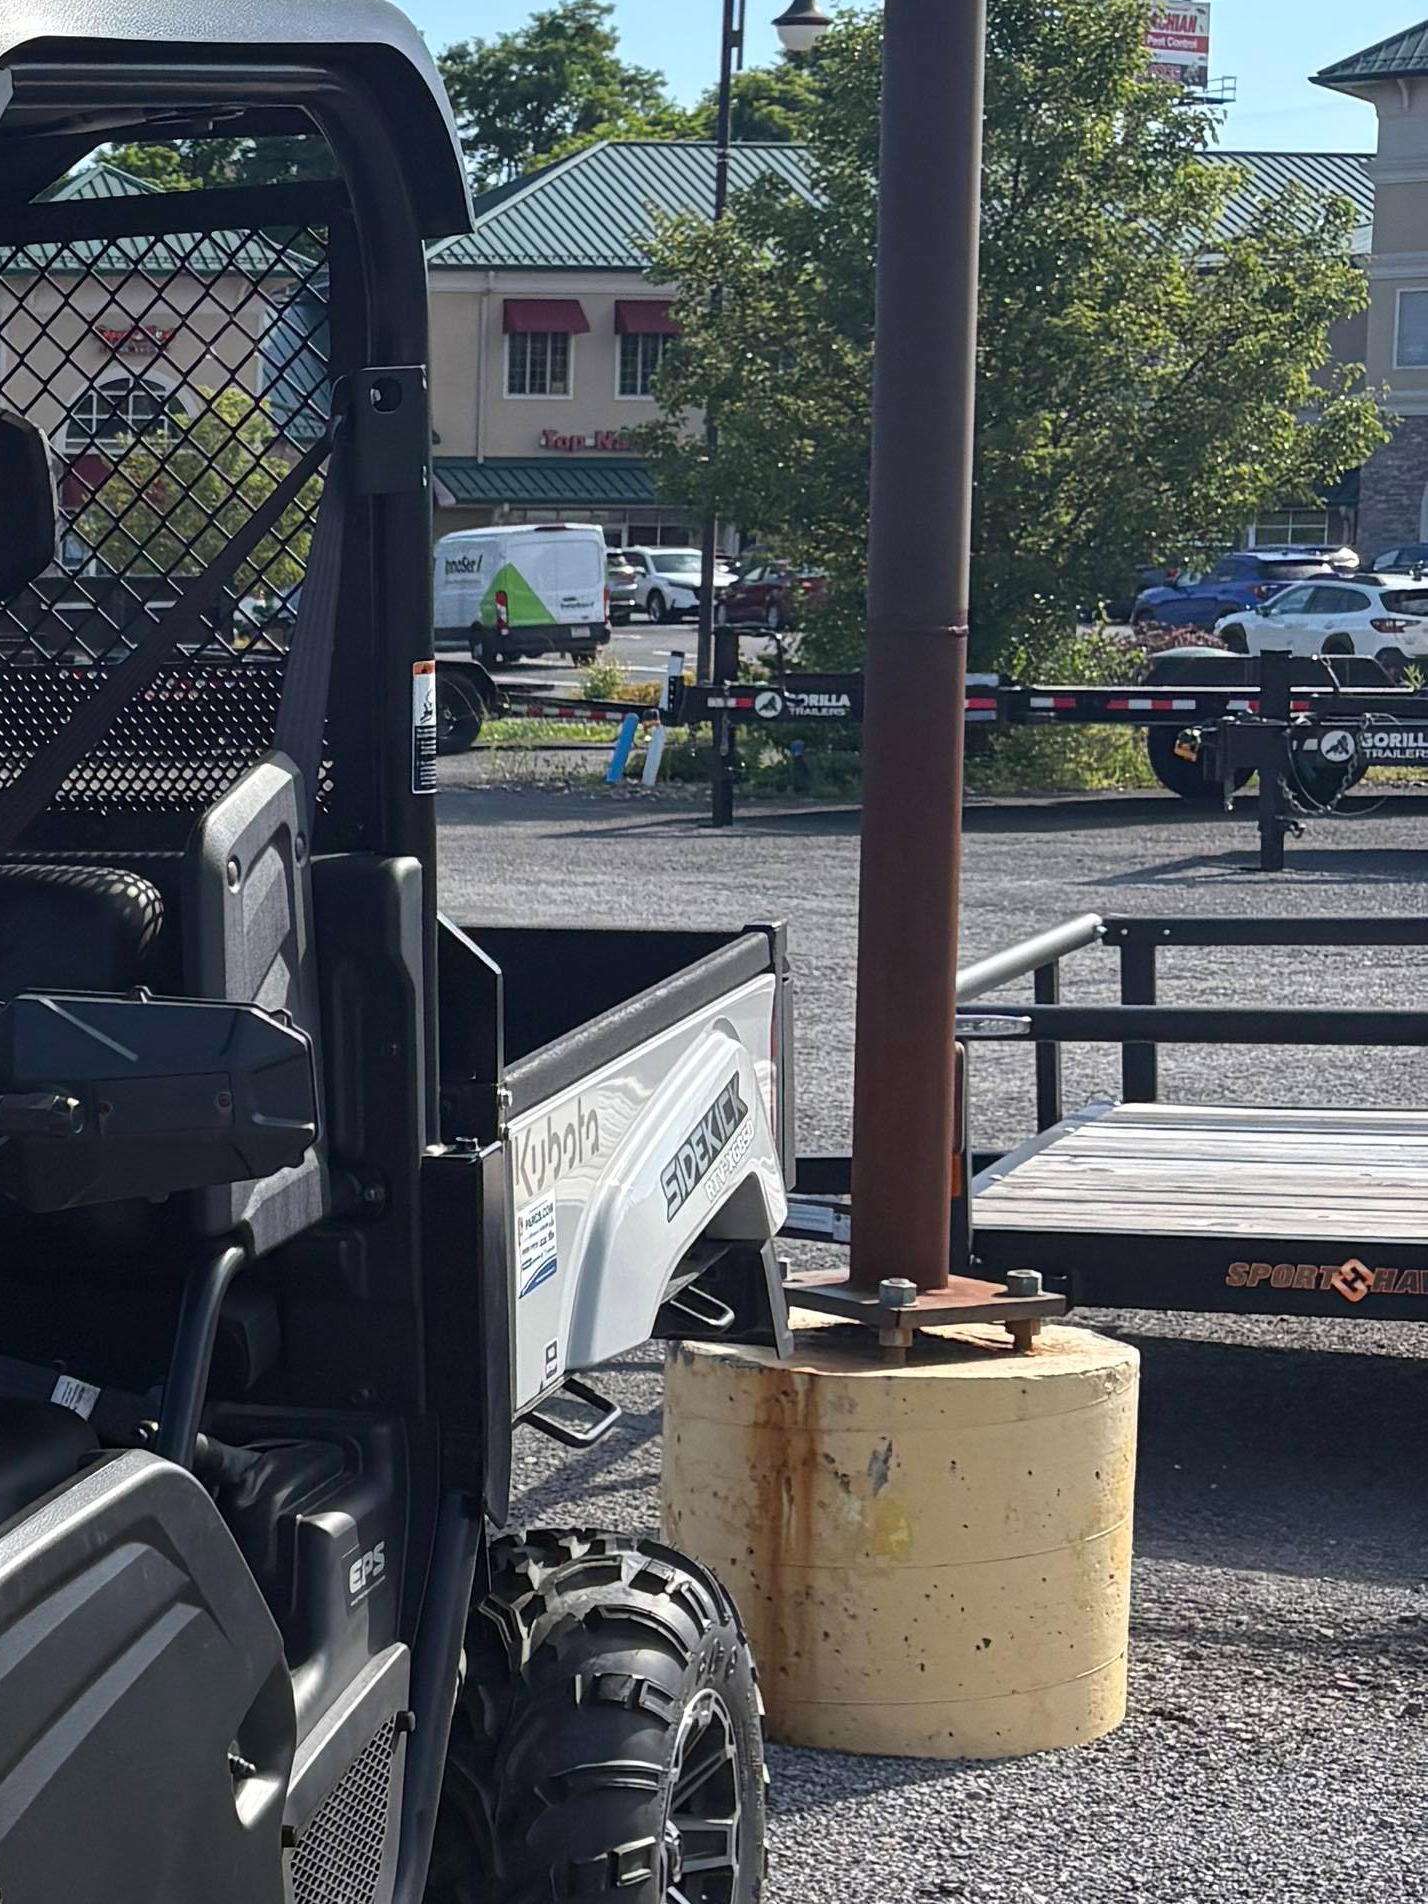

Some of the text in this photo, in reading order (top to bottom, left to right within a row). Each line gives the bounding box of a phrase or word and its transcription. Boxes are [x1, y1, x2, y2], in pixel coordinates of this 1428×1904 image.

[514, 1096, 600, 1198] Kubota
[660, 1071, 748, 1222] SIDEKICK
[1226, 1262, 1343, 1290] SPORT
[349, 1540, 385, 1594] EPS
